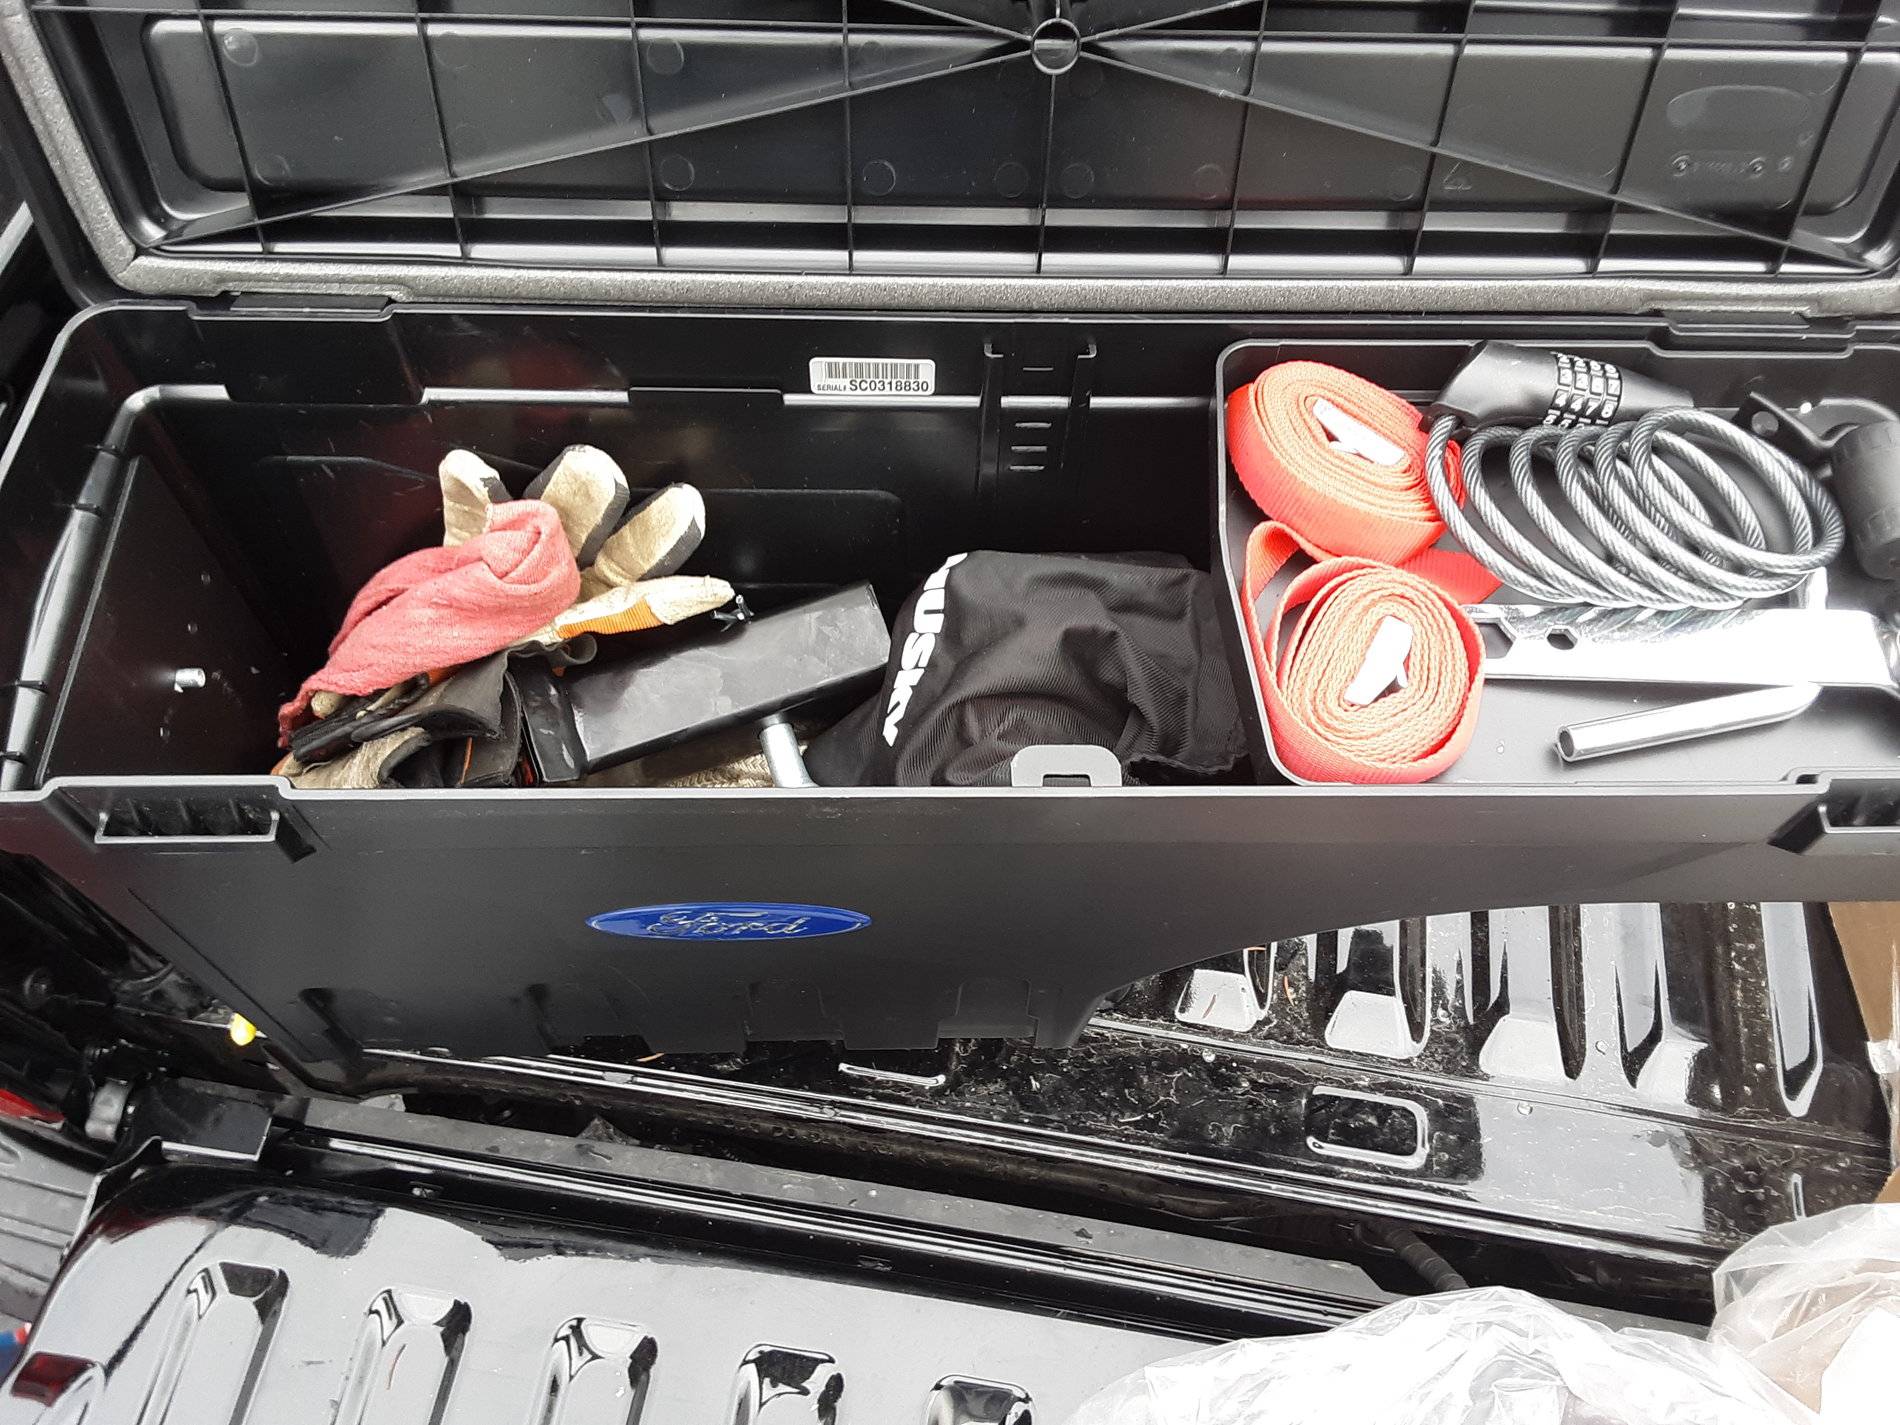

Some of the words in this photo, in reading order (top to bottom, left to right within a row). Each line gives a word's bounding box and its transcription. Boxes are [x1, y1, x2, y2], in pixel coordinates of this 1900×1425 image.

[849, 379, 929, 392] SC0318830
[882, 552, 969, 747] HUSKY
[647, 910, 812, 936] Ford
